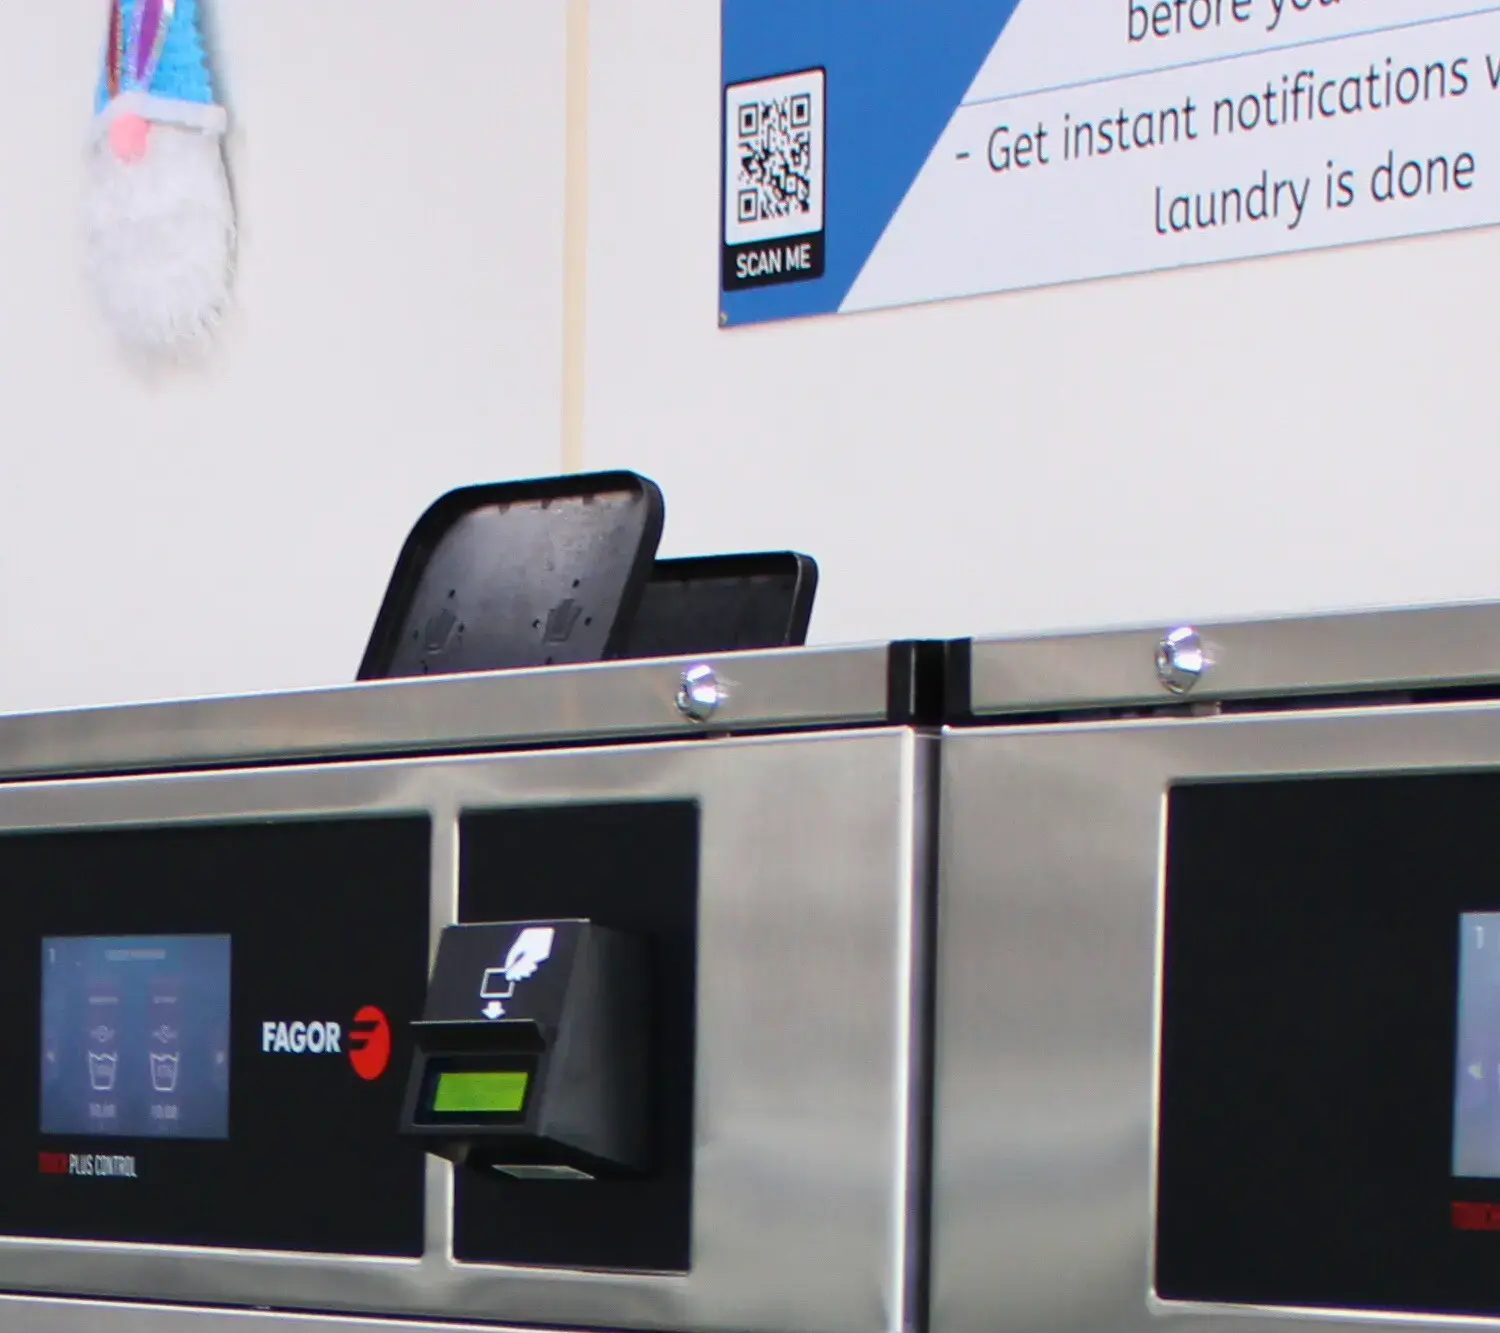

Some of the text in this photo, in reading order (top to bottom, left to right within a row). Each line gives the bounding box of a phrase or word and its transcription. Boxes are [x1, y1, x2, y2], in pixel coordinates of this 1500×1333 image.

[1128, 0, 1250, 43] before
[987, 120, 1049, 174] Get
[1063, 96, 1198, 162] instant
[1212, 56, 1469, 136] notifications
[1154, 149, 1476, 235] laundry is done
[736, 242, 812, 279] SCAN ME
[262, 1021, 342, 1054] FAGOR
[69, 1153, 94, 1176] PLUS
[94, 1154, 138, 1178] CONTROL
